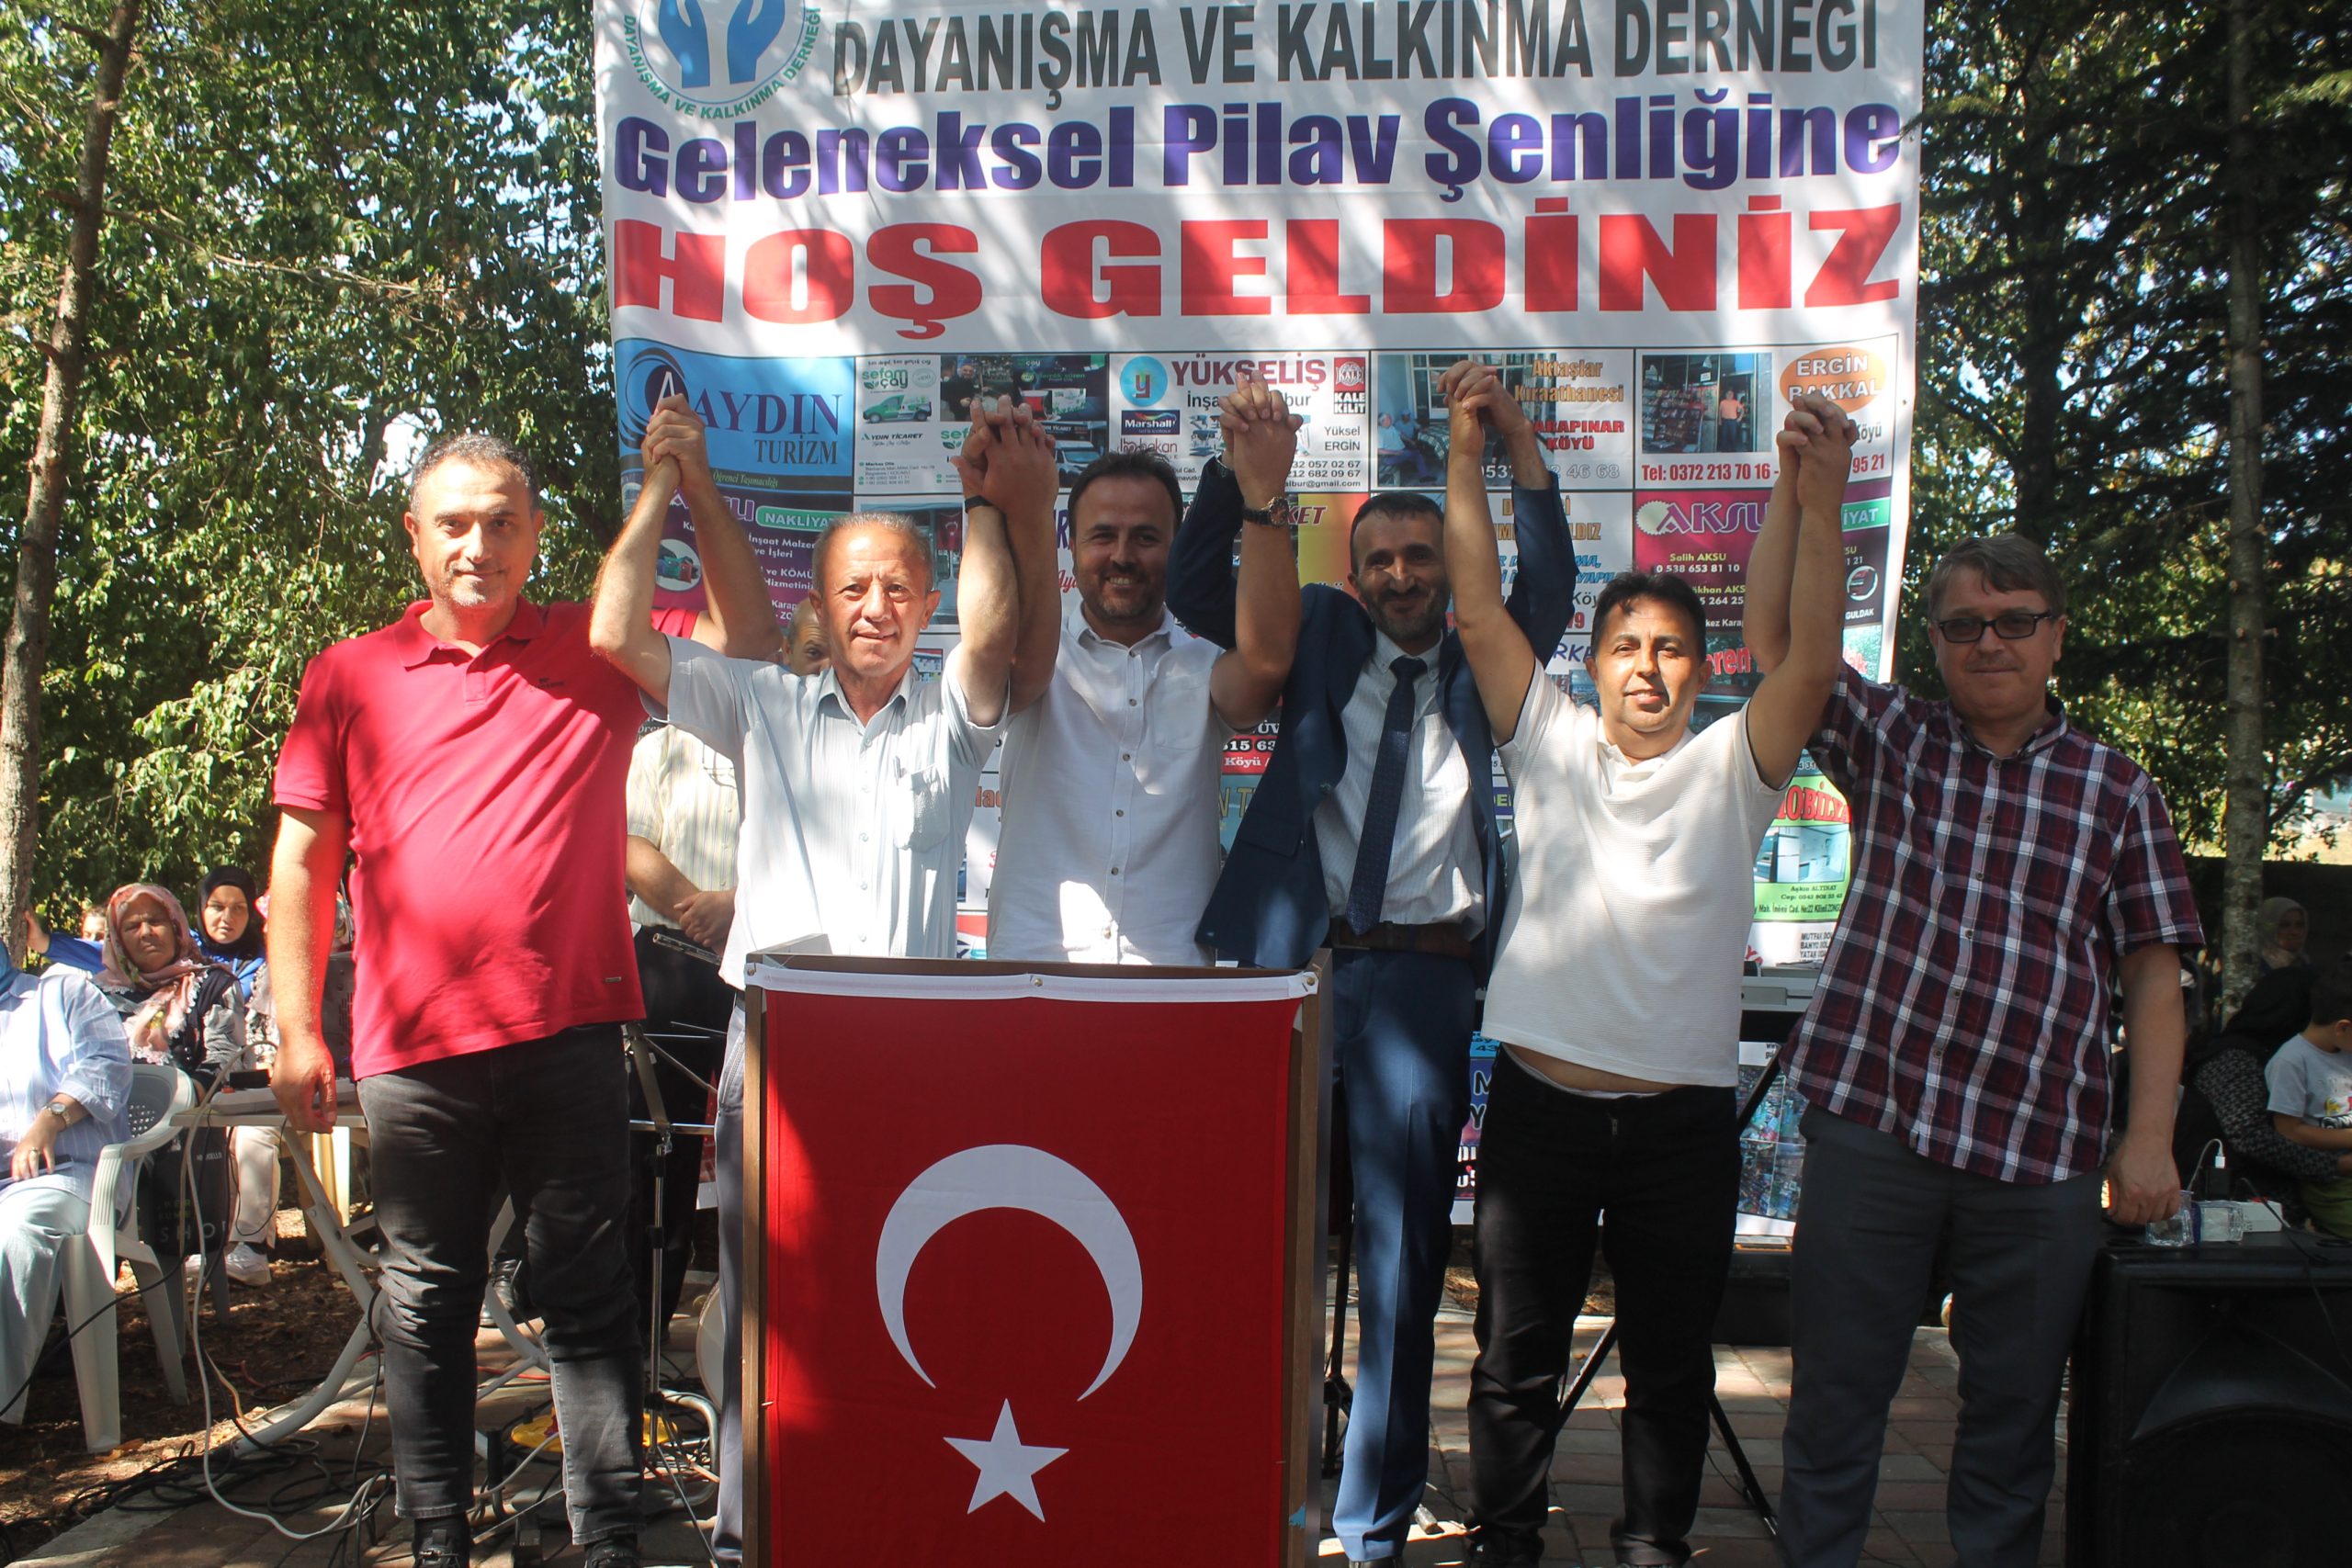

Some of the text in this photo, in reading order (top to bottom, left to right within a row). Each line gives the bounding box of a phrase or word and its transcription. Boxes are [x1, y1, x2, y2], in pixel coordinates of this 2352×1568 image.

[833, 7, 1161, 110] DAYANIŞMA
[1181, 5, 1255, 85] VE
[1278, 0, 1593, 83] KALKINMA
[674, 98, 696, 116] VE
[700, 80, 785, 119] KALKINMA
[615, 88, 1901, 203] Geleneksel Pilav Şenliğine
[614, 195, 1902, 340] HOŞ GELDİNİZ
[1532, 358, 1603, 380] Aktaşlar
[1796, 353, 1869, 377] ERGİN
[1187, 390, 1311, 411] İnşa bur
[1334, 391, 1365, 402] KALE
[1514, 384, 1624, 402] Kıraathanesi
[695, 388, 843, 435] AYDIN
[1125, 419, 1172, 429] Marshall
[1324, 425, 1361, 436] Yüksel
[1533, 420, 1625, 433] ARAPINAR
[940, 427, 970, 440] sef
[1324, 440, 1361, 451] ERGİN
[1545, 434, 1595, 450] KÖYÜ
[754, 435, 838, 465] TURİZM
[1307, 460, 1329, 468] 057
[1331, 460, 1345, 468] 02
[1348, 460, 1361, 468] 67
[1852, 453, 1885, 473] 95 21
[1307, 469, 1329, 478] 682
[1331, 469, 1345, 478] 09
[1348, 469, 1361, 478] 67
[1566, 464, 1591, 479] 46
[1596, 464, 1621, 479] 68
[1642, 465, 1667, 480] Tel:
[1669, 464, 1703, 480] 0372
[1706, 463, 1732, 480] 213
[1735, 463, 1751, 479] 70
[1754, 463, 1770, 479] 16
[1286, 479, 1361, 488] albur@gmail.com
[764, 512, 831, 528] NAKLİYA
[1669, 553, 1727, 562] Salih AKSU
[780, 566, 813, 579] KÖMÜ
[1666, 565, 1686, 573] 538
[1688, 565, 1708, 573] 653
[1711, 565, 1724, 573] 81
[1728, 565, 1740, 573] 10
[1724, 584, 1747, 594] AKS
[1709, 597, 1728, 605] 264
[1224, 756, 1261, 768] Köyü
[1777, 781, 1852, 824] OBİLYA
